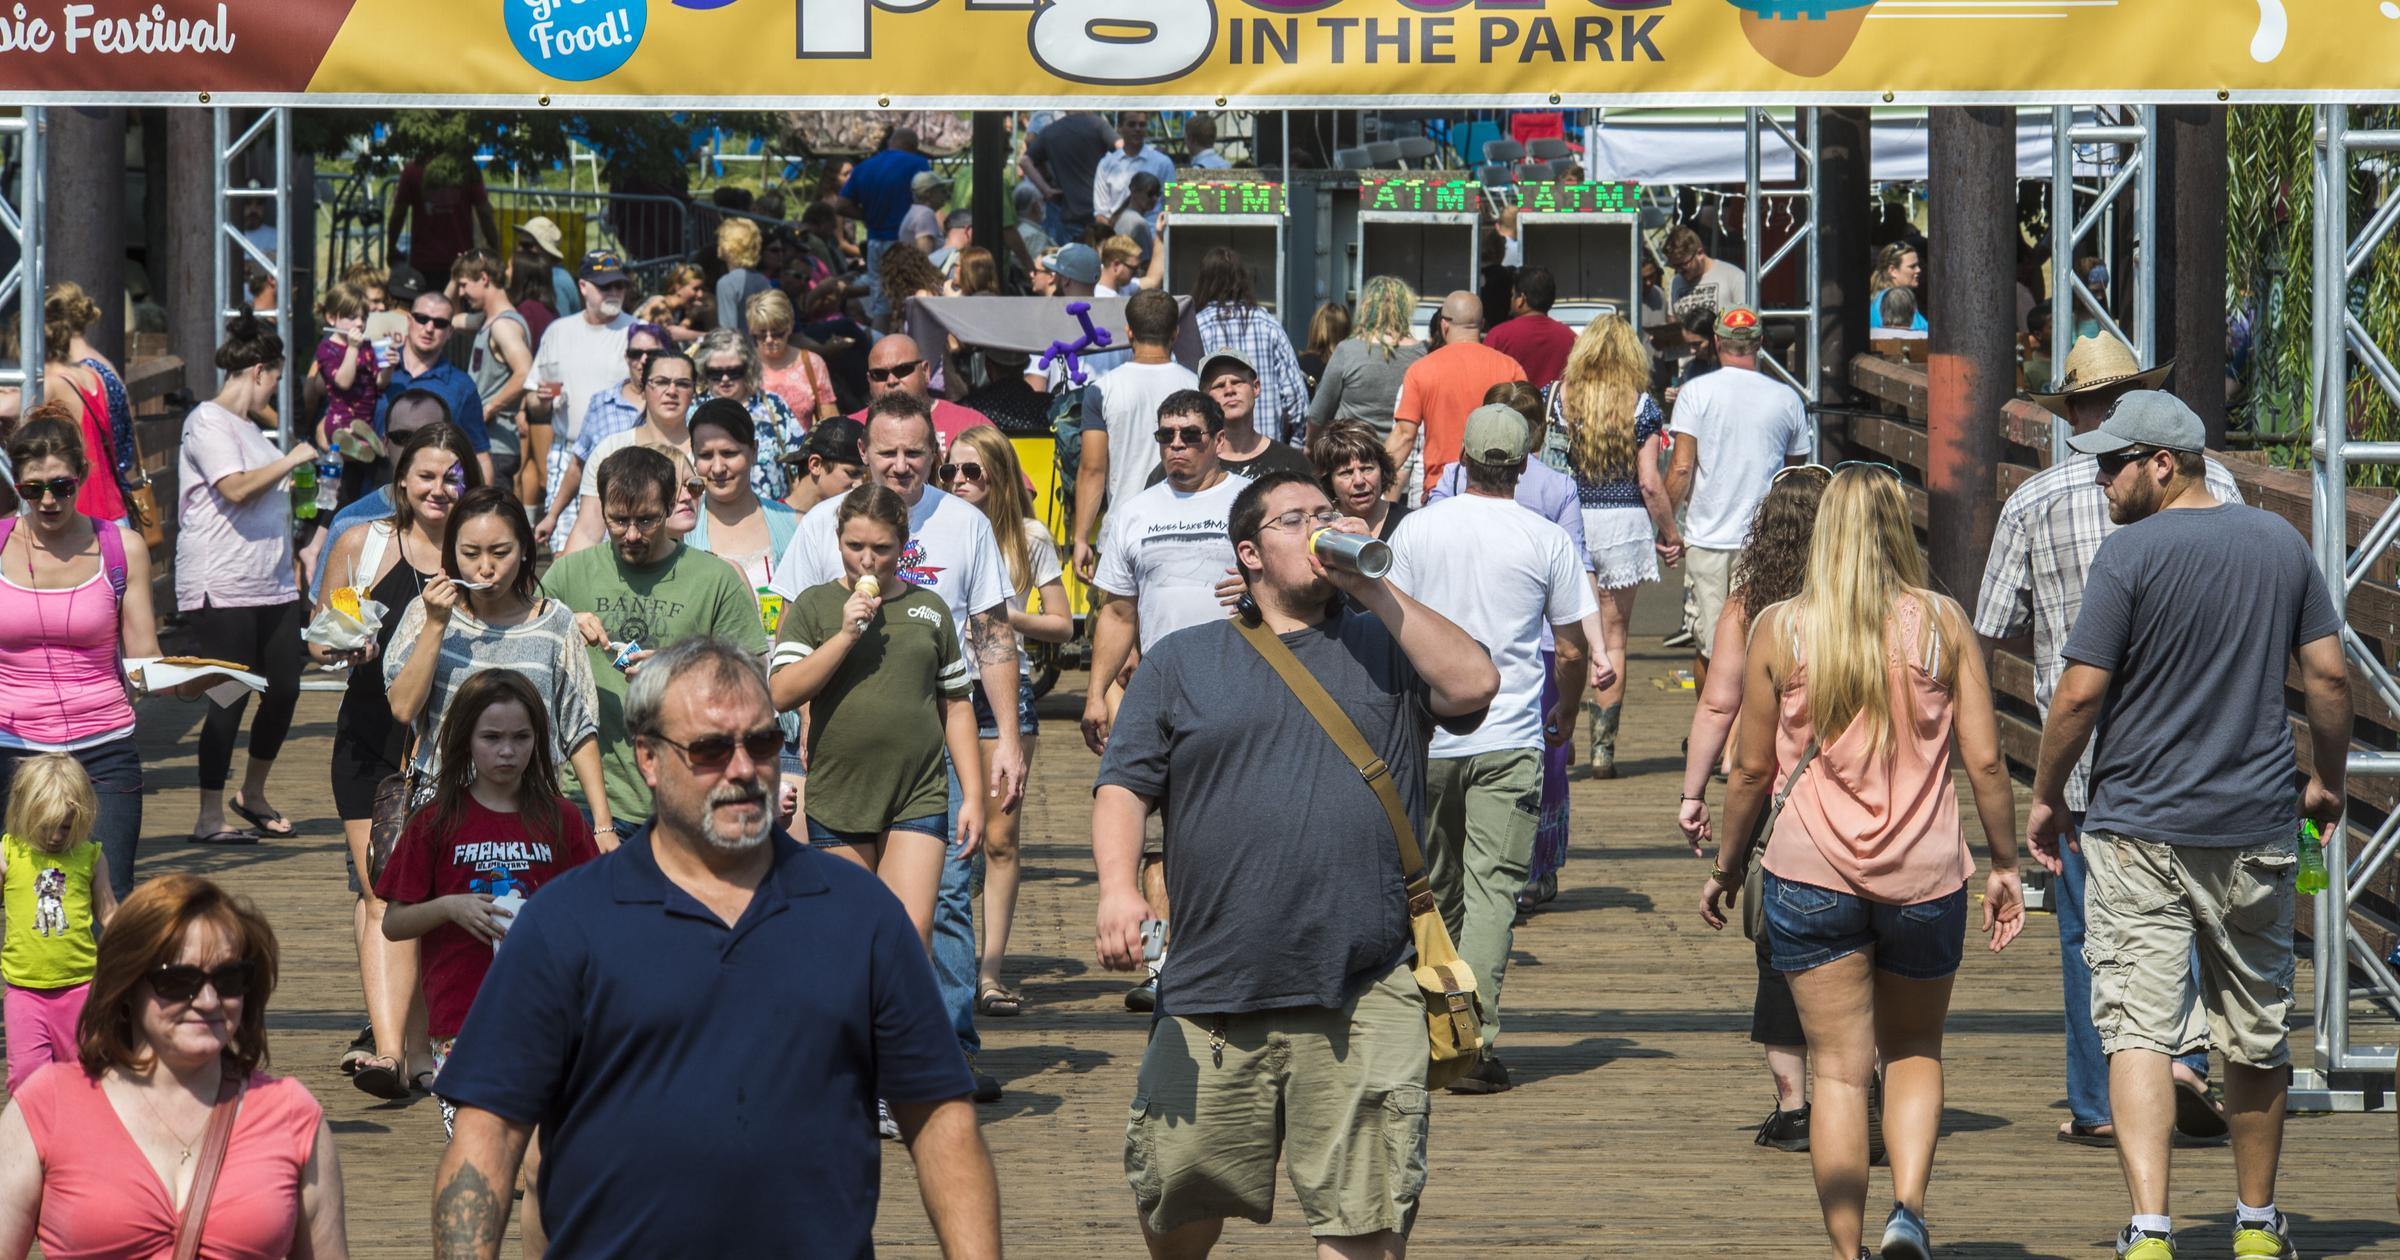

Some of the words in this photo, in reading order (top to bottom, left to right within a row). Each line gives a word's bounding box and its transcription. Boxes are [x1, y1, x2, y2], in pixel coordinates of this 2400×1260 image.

[63, 2, 236, 54] Festival
[529, 8, 633, 59] Food!
[1230, 17, 1298, 64] IN
[1317, 17, 1456, 64] THE
[1480, 15, 1665, 63] PARK
[1180, 190, 1270, 212] ATM
[1373, 186, 1465, 210] ATM
[1534, 185, 1624, 207] ATM
[595, 596, 685, 617] BANFF
[453, 841, 552, 865] FRANKLIN
